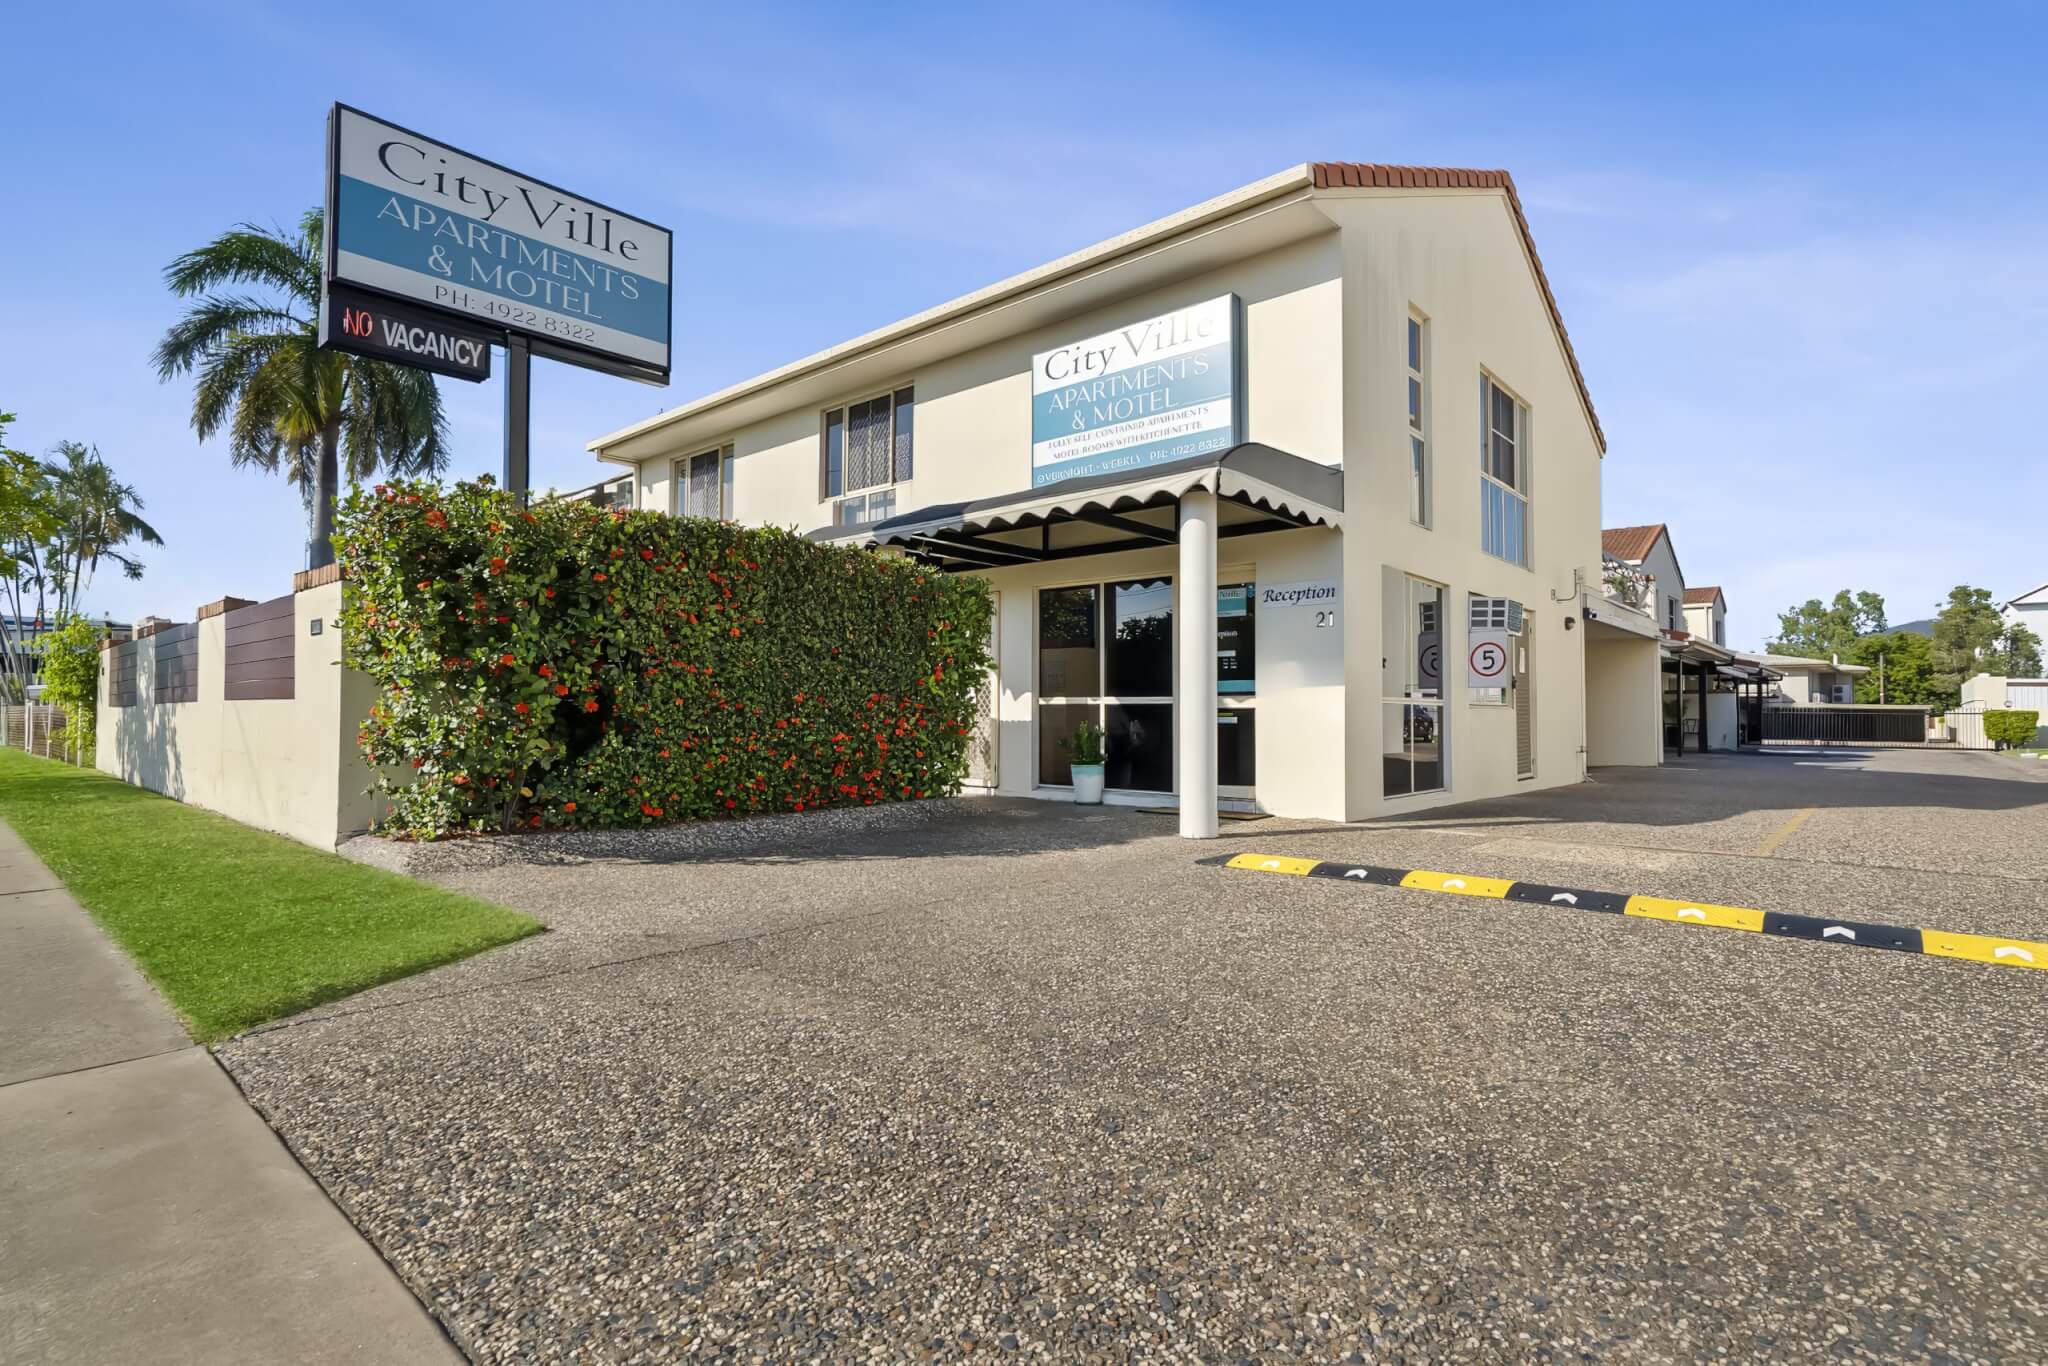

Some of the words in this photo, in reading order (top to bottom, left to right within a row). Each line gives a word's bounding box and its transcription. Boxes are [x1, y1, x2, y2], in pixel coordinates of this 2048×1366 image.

[376, 196, 640, 300] APARTMENTS
[427, 244, 453, 277] &
[470, 257, 603, 320] MOTEL
[434, 285, 476, 310] PH:
[483, 300, 537, 328] 4922
[544, 316, 596, 343] 8322
[343, 307, 373, 338] NO
[382, 319, 483, 368] VACANCY
[1049, 353, 1209, 414] APARTMENTS
[1072, 410, 1086, 430] &
[1094, 387, 1179, 423] MOTEL
[1096, 420, 1145, 439] CONTAINED
[1147, 406, 1209, 426] APARTMENTS
[1037, 464, 1093, 483] OVERNIGHT
[1102, 454, 1142, 470] WEEKLY
[1053, 448, 1079, 460] MOTEL
[1082, 441, 1114, 455] ROOMS
[1263, 585, 1336, 606] Reception
[1315, 611, 1335, 628] 21
[1482, 650, 1495, 670] 5
